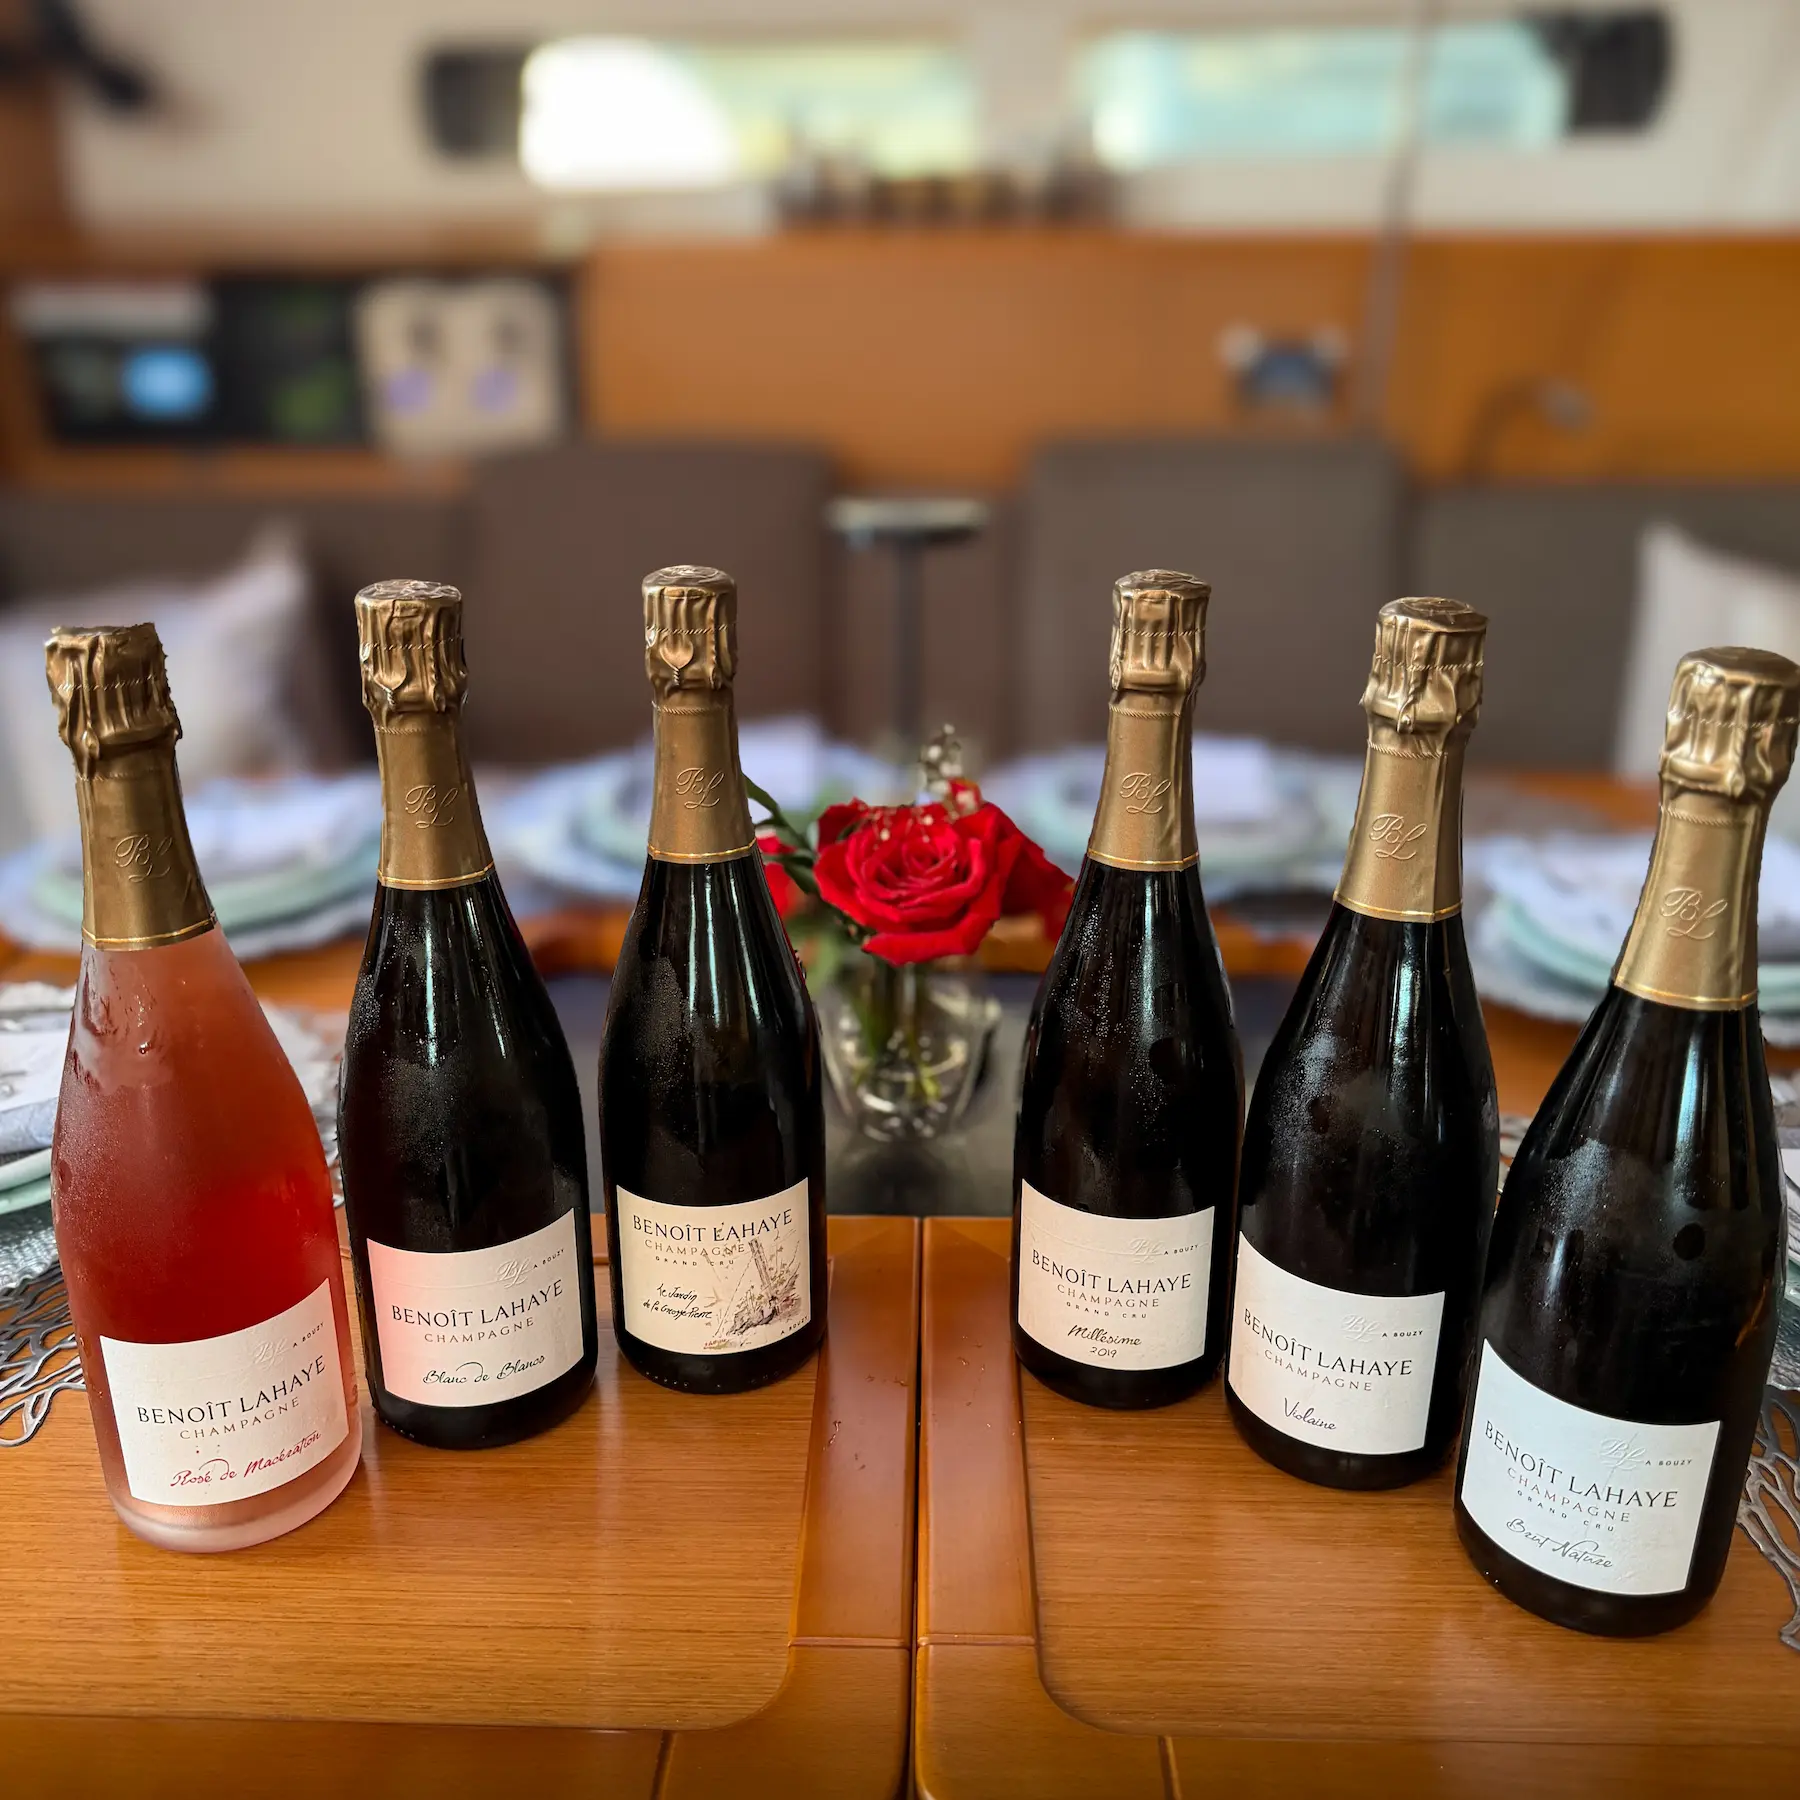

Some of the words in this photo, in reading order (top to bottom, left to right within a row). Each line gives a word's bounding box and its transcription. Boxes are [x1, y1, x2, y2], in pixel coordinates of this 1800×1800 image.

[633, 1215, 706, 1242] BENOÎT
[713, 1208, 793, 1242] LAHAYE
[542, 1248, 565, 1265] BOUZY
[645, 1239, 745, 1256] CHAMPAGNE
[656, 1256, 698, 1266] GRAND
[1174, 1244, 1199, 1255] BOUZY
[1032, 1249, 1102, 1289] BENOÎT
[1107, 1273, 1191, 1294] LAHAYE
[392, 1305, 473, 1327] BENOÎT
[481, 1279, 563, 1324] LAHAYE
[1057, 1284, 1160, 1308] CHAMPAGNE
[1066, 1301, 1110, 1316] GRAND
[424, 1316, 534, 1343] CHAMPAGNE
[1067, 1324, 1142, 1346] Millésime
[1244, 1308, 1312, 1361] BENOÎT
[1318, 1351, 1413, 1376] LAHAYE
[422, 1369, 468, 1385] Blanc
[455, 1361, 490, 1382] de
[496, 1354, 546, 1380] Blancs
[1089, 1347, 1118, 1358] 2019
[1264, 1349, 1372, 1392] CHAMPAGNE
[137, 1400, 231, 1425] BENOÎT
[240, 1355, 325, 1413] LAHAYE
[180, 1396, 300, 1440] CHAMPAGNE
[1284, 1397, 1337, 1431] Violaine
[170, 1469, 212, 1487] Rosé
[199, 1458, 237, 1480] de
[243, 1430, 321, 1478] Macération
[1485, 1420, 1563, 1484] BENOÎT
[1569, 1476, 1678, 1508] LAHAYE
[1507, 1467, 1630, 1523] CHAMPAGNE
[1517, 1490, 1567, 1519] GRAND
[1583, 1520, 1614, 1532] CRU
[1506, 1518, 1555, 1547] Brut
[1552, 1539, 1613, 1568] Nature
